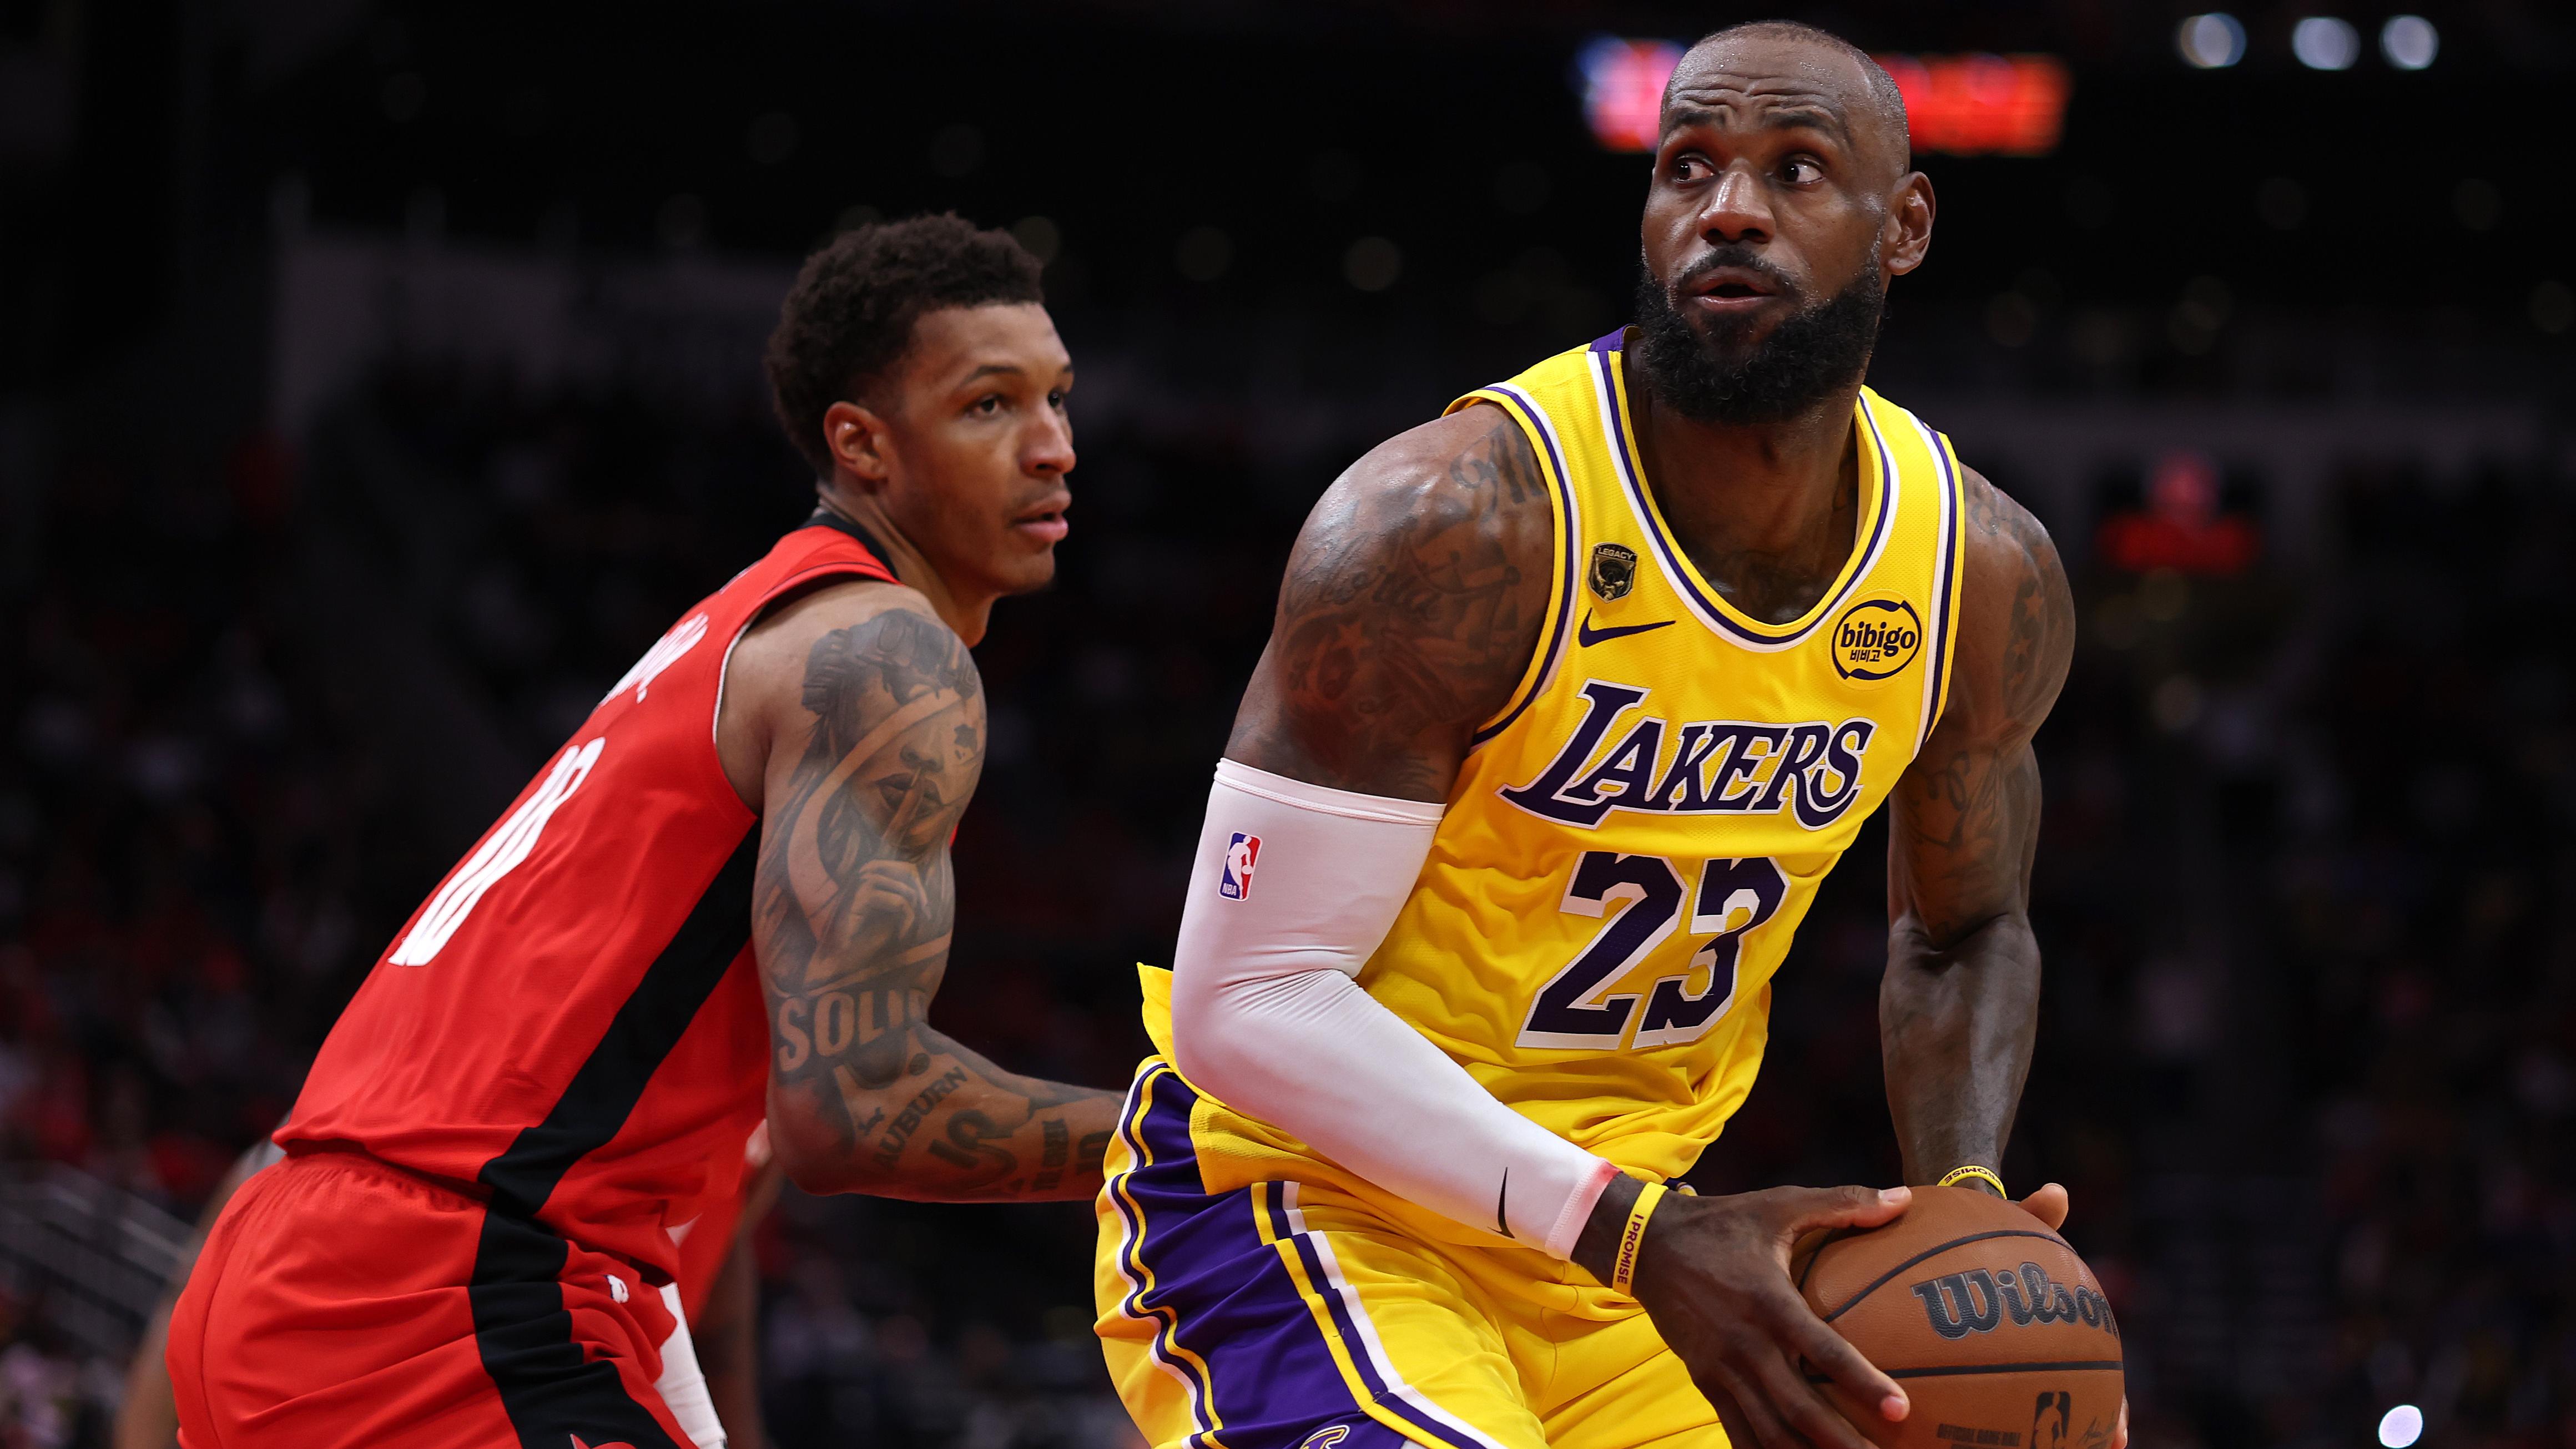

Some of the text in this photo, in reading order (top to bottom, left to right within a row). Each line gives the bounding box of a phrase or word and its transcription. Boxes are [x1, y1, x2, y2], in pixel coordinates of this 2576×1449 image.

[1598, 547, 1633, 560] LEGACY
[1841, 621, 1915, 657] bibigo
[1849, 649, 1881, 662] 비비고
[1500, 679, 1878, 831] LAKERS
[1222, 882, 1237, 896] NBA
[1515, 851, 1791, 1050] 23
[872, 1066, 967, 1171] AUBURN
[1617, 1221, 1641, 1285] PROMISE
[1910, 1262, 2119, 1341] Wilson
